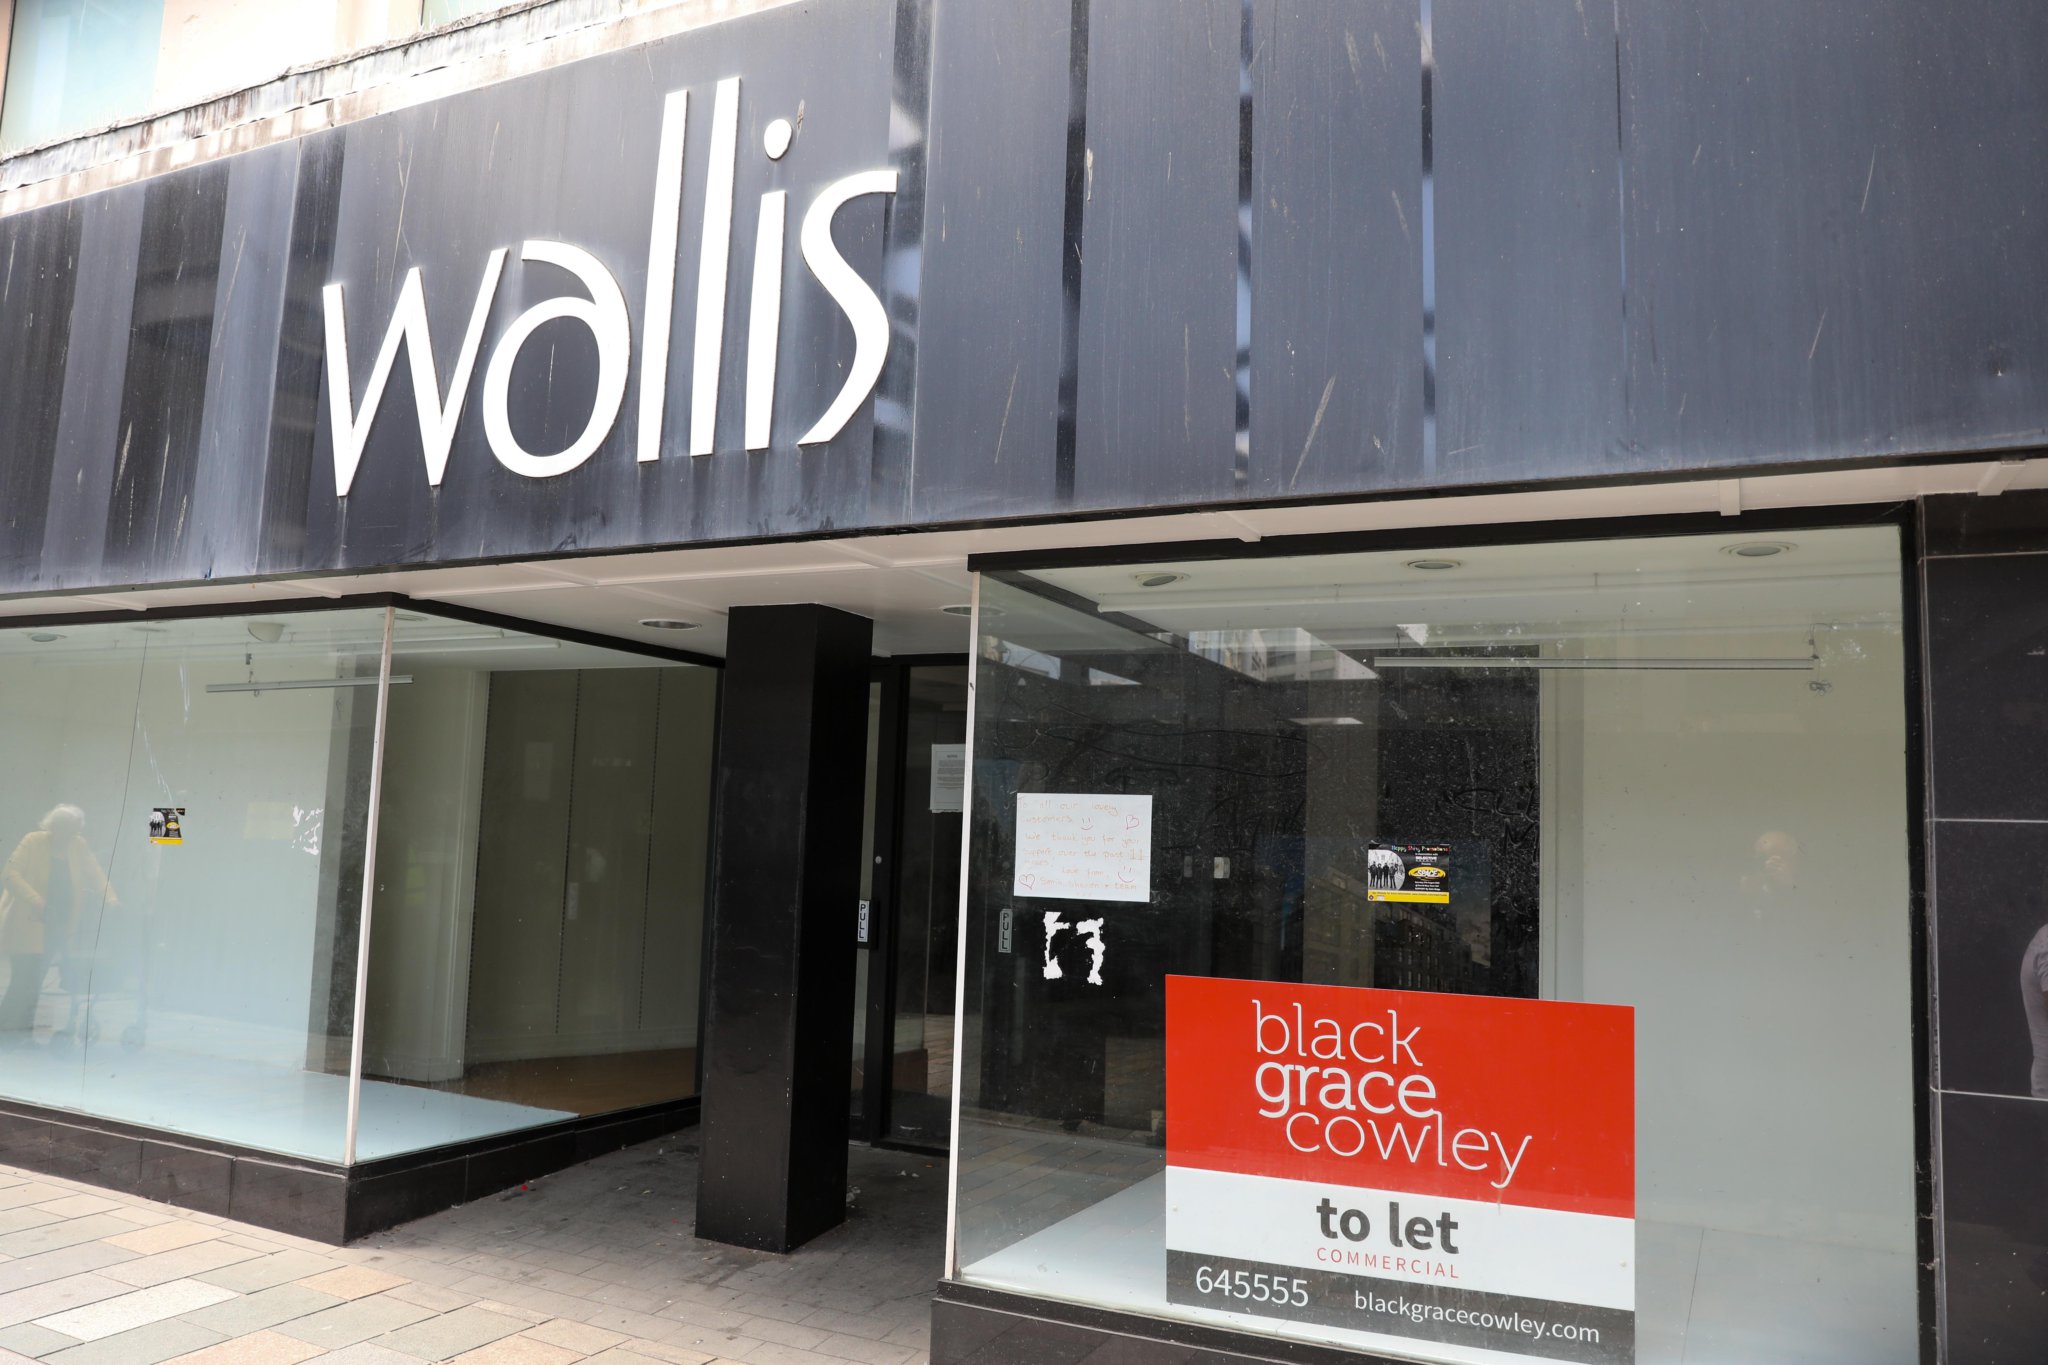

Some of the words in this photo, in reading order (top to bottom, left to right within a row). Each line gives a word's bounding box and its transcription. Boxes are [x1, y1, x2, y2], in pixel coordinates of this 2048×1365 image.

[323, 77, 897, 497] wallis
[859, 903, 867, 939] PULL
[1001, 912, 1010, 950] PULL
[1252, 1000, 1423, 1066] black
[1254, 1061, 1437, 1119] grace
[1286, 1111, 1532, 1188] cowley
[1316, 1197, 1371, 1242] to
[1389, 1202, 1459, 1254] let
[1196, 1266, 1309, 1307] 645555
[1316, 1247, 1460, 1279] COMMERCIAL
[1355, 1290, 1600, 1343] blackgracecowley.com
